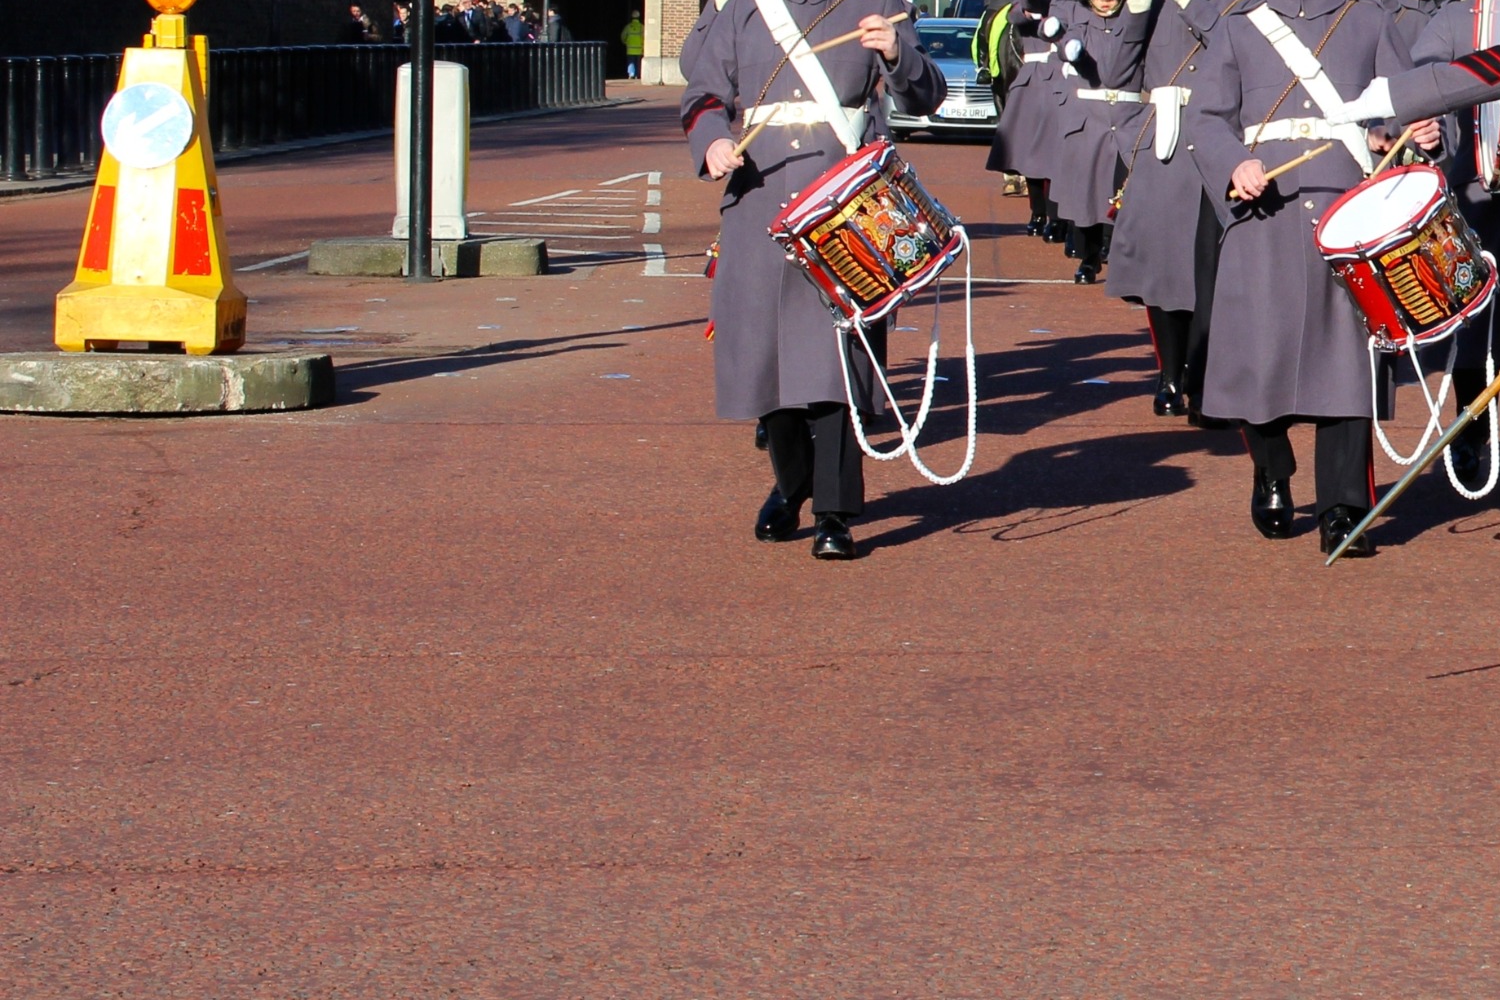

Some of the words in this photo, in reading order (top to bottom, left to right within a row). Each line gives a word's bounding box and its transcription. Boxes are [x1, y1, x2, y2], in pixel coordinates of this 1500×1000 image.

[945, 108, 968, 117] LP62
[969, 108, 986, 118] URU
[849, 184, 878, 211] IRISH
